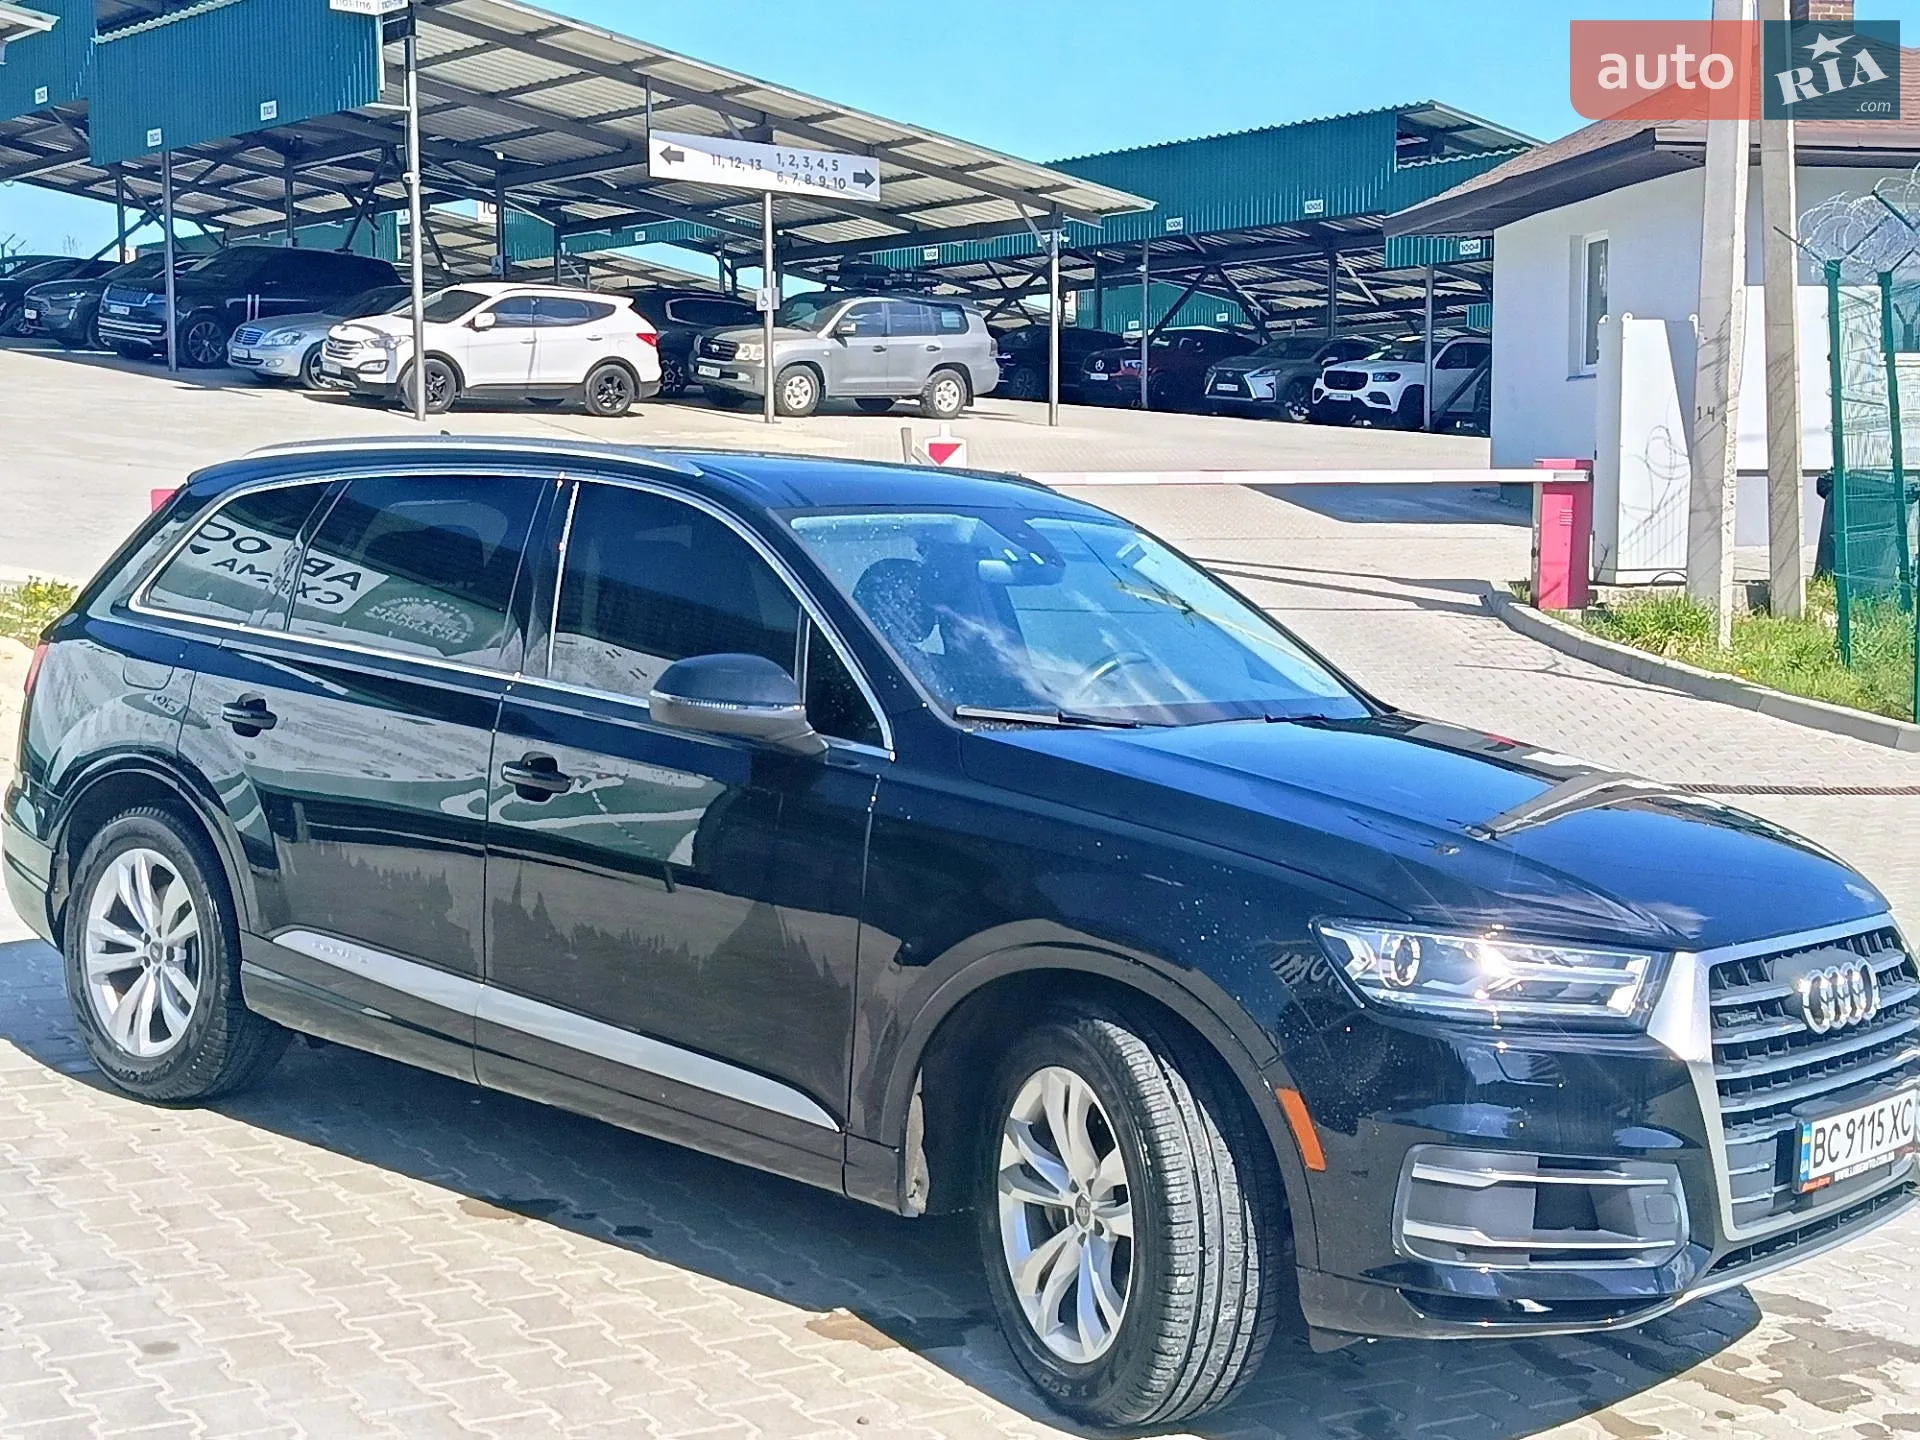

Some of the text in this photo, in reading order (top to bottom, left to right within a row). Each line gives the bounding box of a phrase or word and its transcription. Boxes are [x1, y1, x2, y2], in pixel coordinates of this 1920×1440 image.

[729, 156, 745, 170] 12,
[750, 158, 762, 171] 13
[776, 153, 839, 172] 1, 2, 3, 4, 5
[833, 177, 846, 190] 10
[1813, 1122, 1841, 1169] BC
[1845, 1107, 1885, 1159] 9115
[1889, 1098, 1913, 1144] XC
